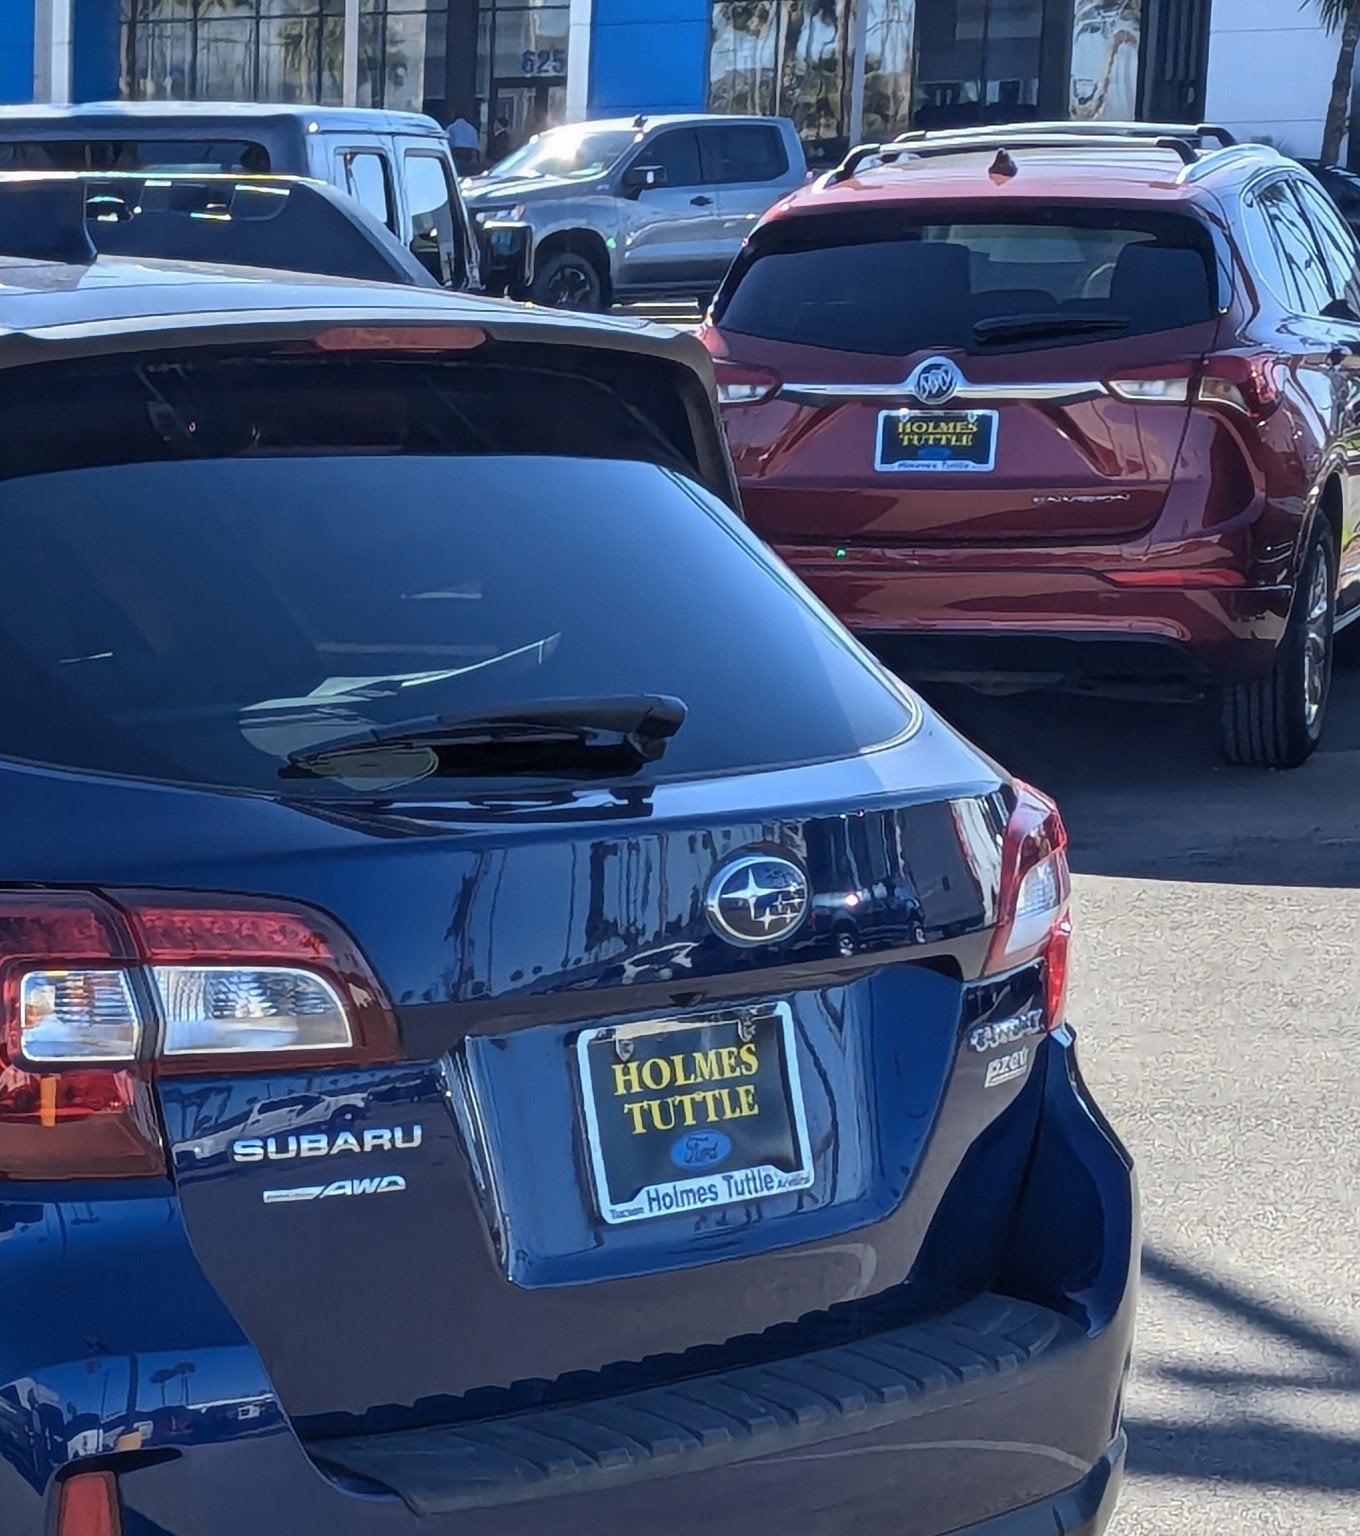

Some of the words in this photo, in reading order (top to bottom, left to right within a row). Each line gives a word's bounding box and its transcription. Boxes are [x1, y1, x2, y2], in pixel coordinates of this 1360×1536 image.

[522, 49, 564, 74] 625
[898, 421, 978, 433] HOLMES
[900, 434, 974, 446] TUTTLE
[612, 1043, 759, 1096] HOLMES
[624, 1085, 759, 1135] TUTTLE
[233, 1125, 422, 1162] SUBARU
[319, 1175, 406, 1199] AWD
[646, 1184, 718, 1213] Holmes
[722, 1172, 775, 1198] Tuttle
